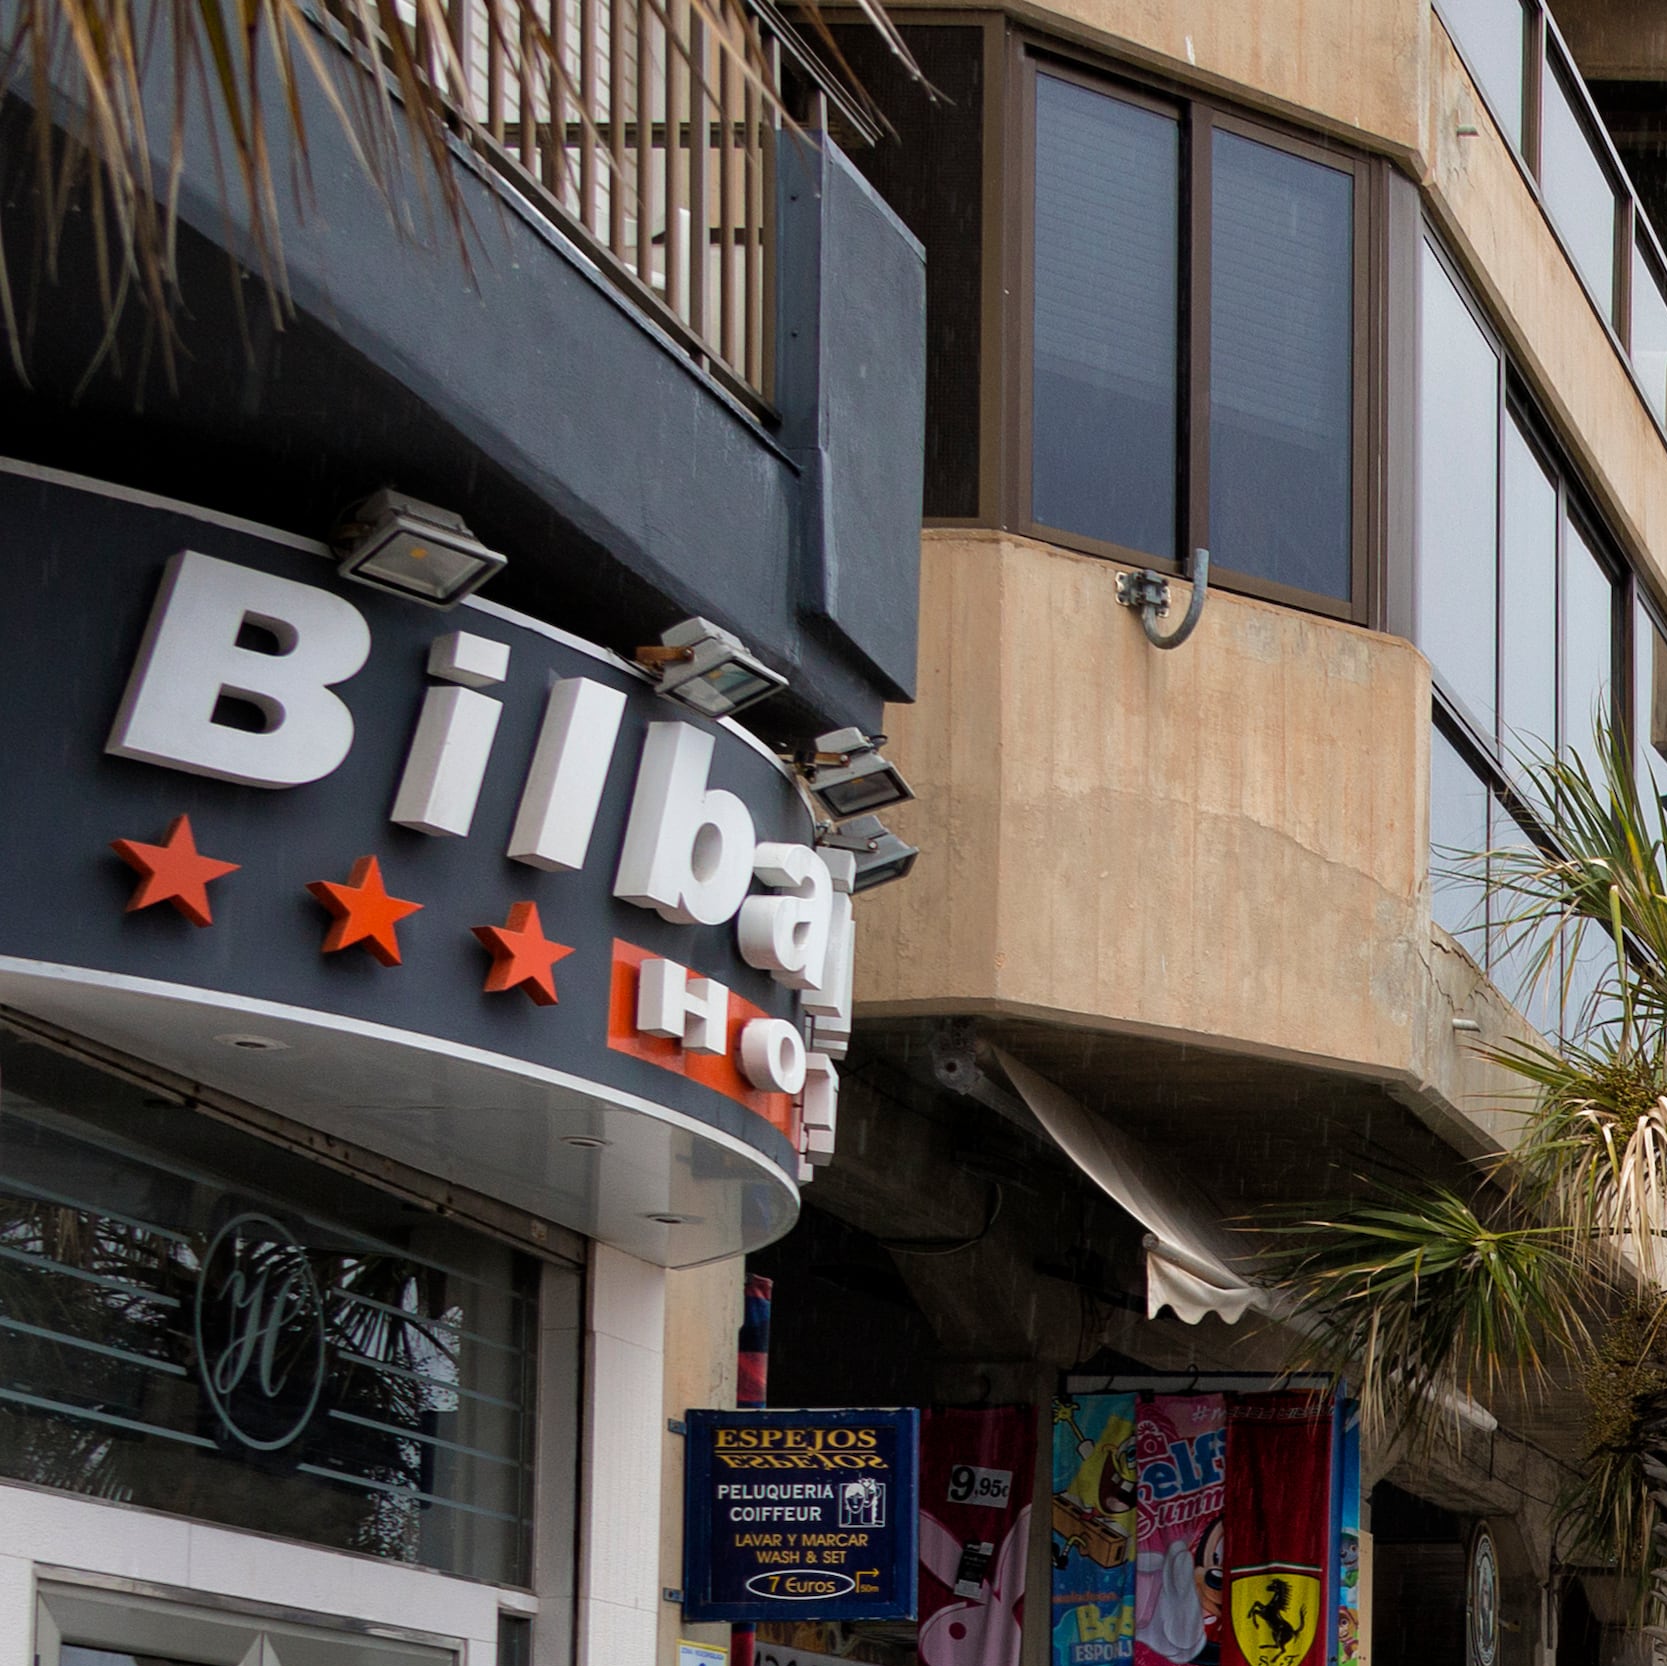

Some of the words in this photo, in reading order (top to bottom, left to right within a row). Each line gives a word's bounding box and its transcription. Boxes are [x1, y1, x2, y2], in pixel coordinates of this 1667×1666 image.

[105, 549, 854, 1017] Bilba
[714, 1428, 878, 1456] ESPEJOS
[717, 1484, 834, 1499] PELUQUERIA
[729, 1506, 822, 1522] COIFFEUR
[734, 1533, 782, 1547] LAVAR
[787, 1533, 798, 1547] Y
[802, 1533, 868, 1547] MARCAR
[756, 1551, 800, 1564] WASH
[805, 1551, 817, 1564] &
[822, 1551, 847, 1564] SET
[768, 1576, 781, 1593] 7
